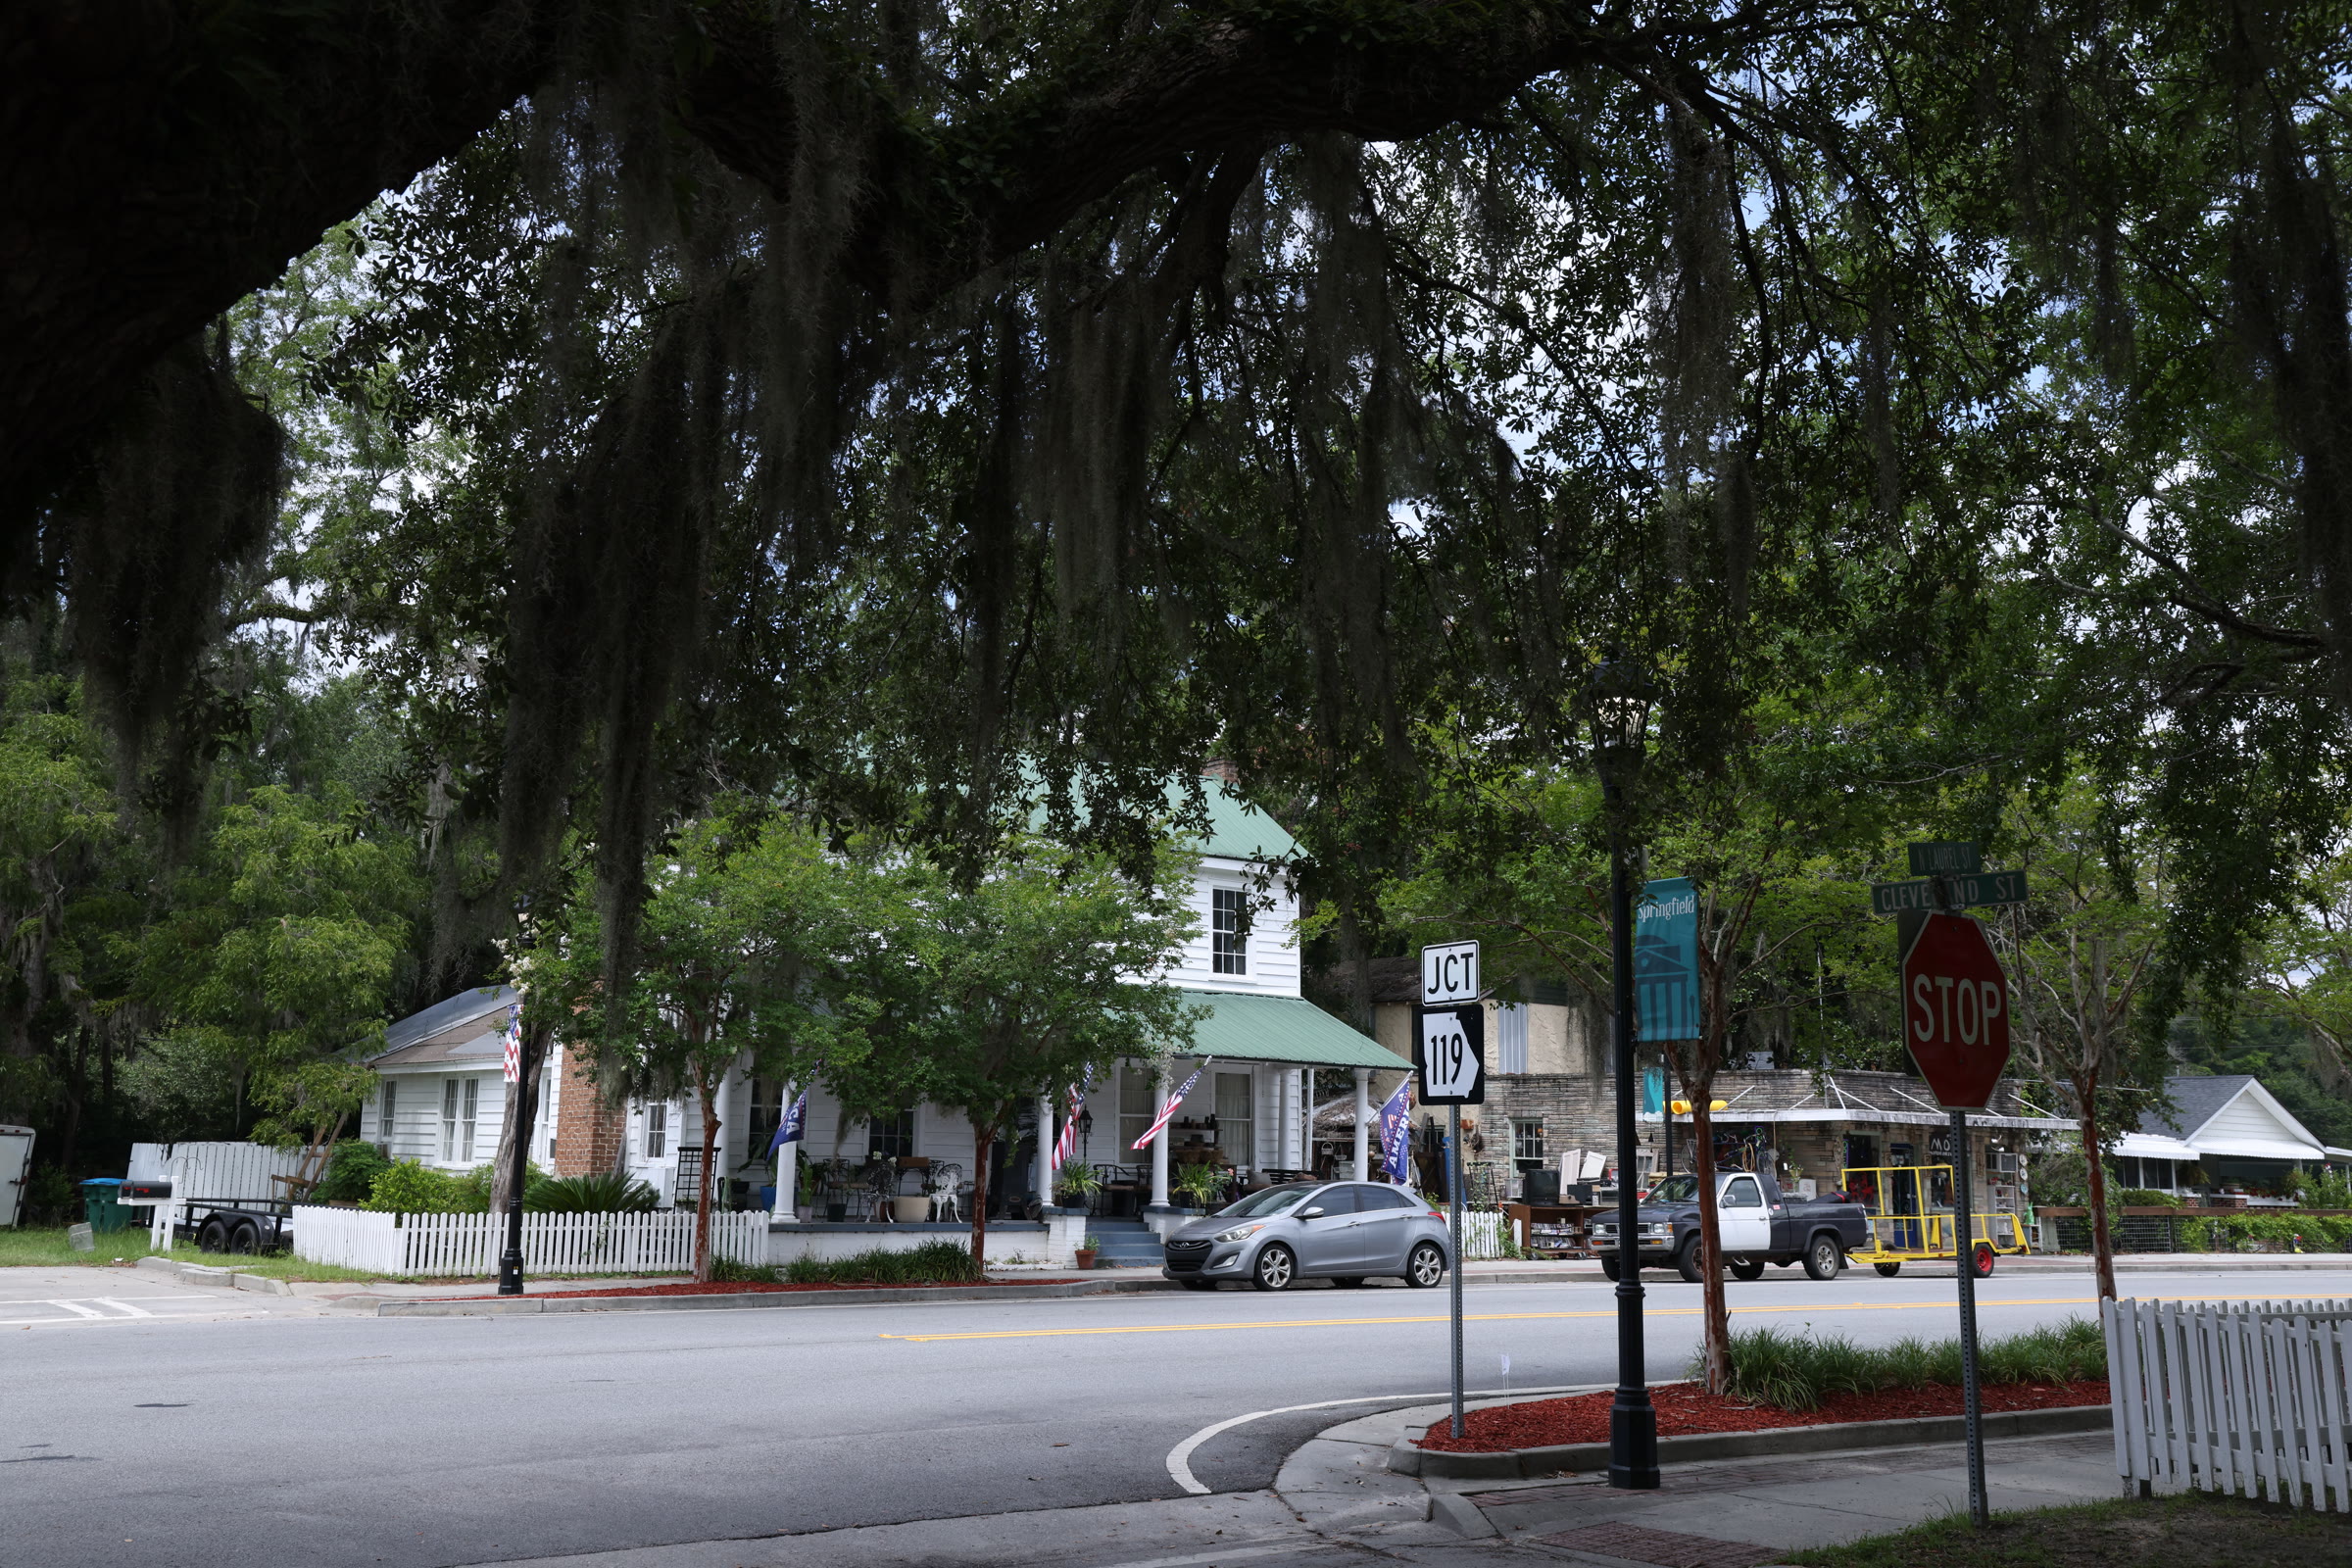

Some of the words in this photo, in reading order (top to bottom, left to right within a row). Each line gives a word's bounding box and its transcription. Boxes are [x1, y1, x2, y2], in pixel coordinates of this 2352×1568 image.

[1918, 849, 1926, 870] N
[1929, 848, 1960, 870] LAUREL
[1963, 847, 1972, 869] ST
[1638, 895, 1694, 923] Springfield
[1881, 879, 1980, 911] CLEVEND
[1995, 875, 2018, 900] ST
[1427, 952, 1474, 995] JCT
[1913, 973, 2002, 1046] STOP
[1430, 1032, 1463, 1086] 119
